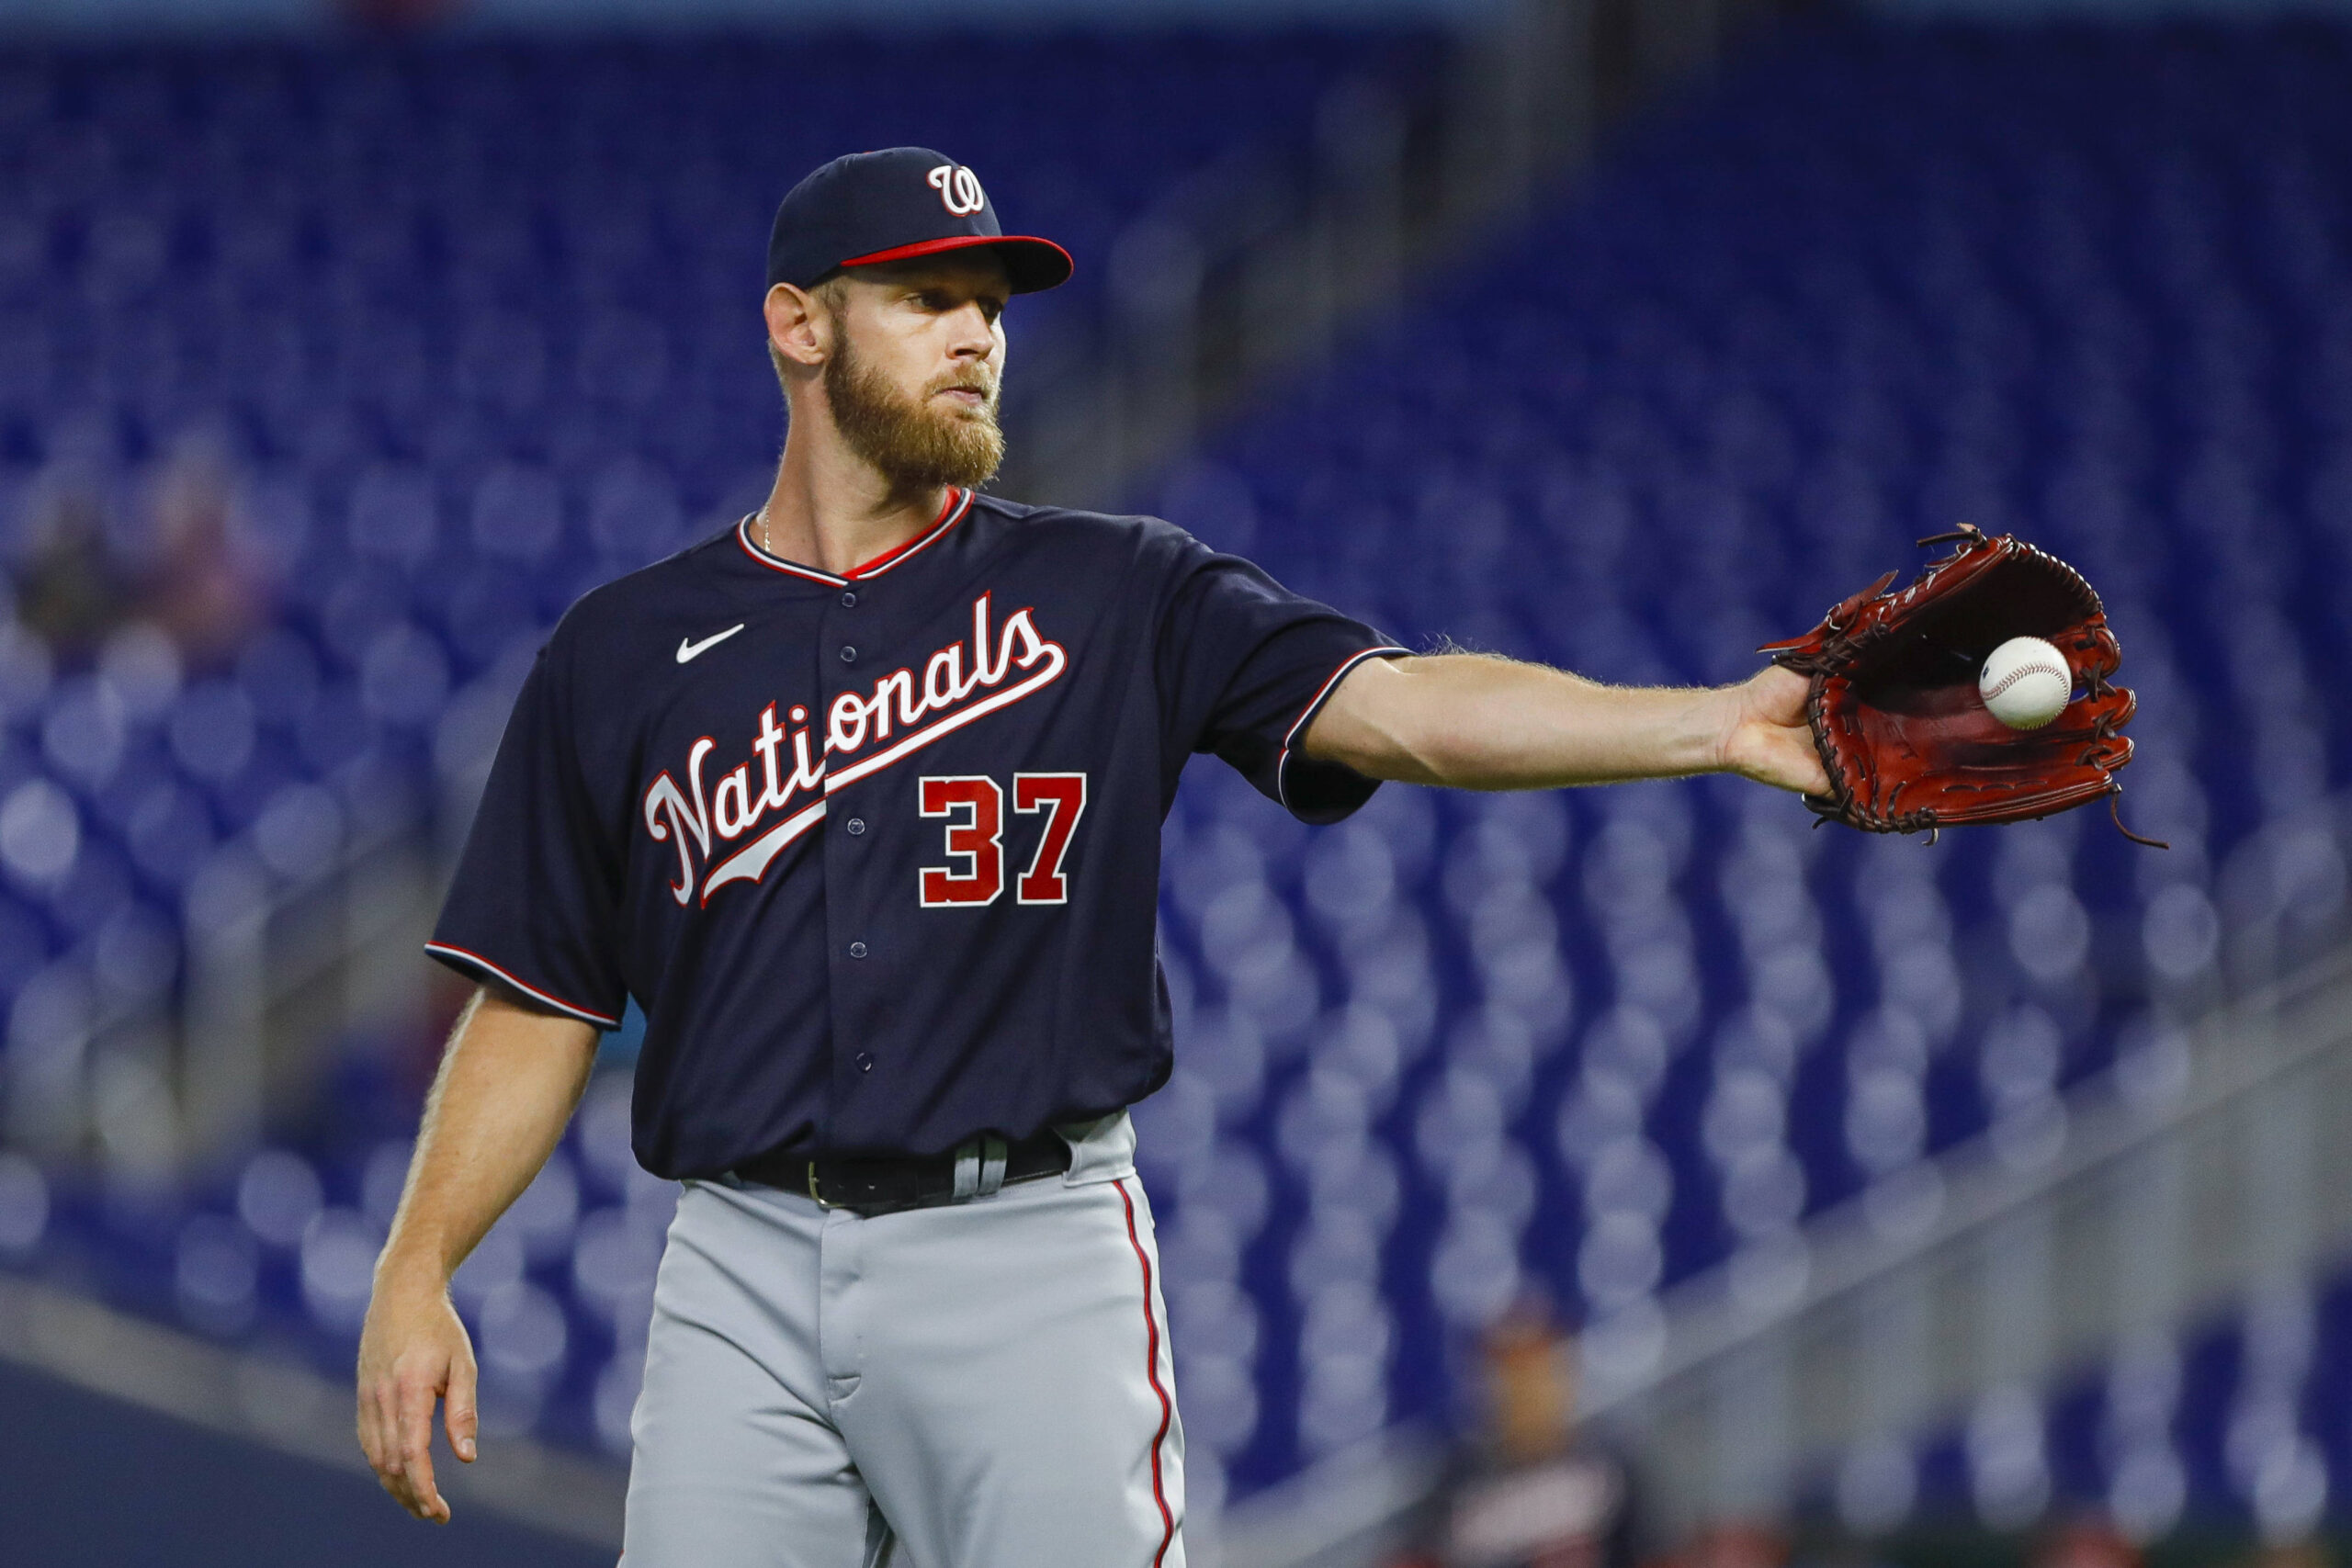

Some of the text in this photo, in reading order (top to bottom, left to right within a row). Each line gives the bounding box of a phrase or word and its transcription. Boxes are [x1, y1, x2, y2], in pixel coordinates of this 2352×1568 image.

[927, 164, 985, 217] W
[645, 590, 1067, 907] Nationals
[919, 773, 1087, 907] 37
